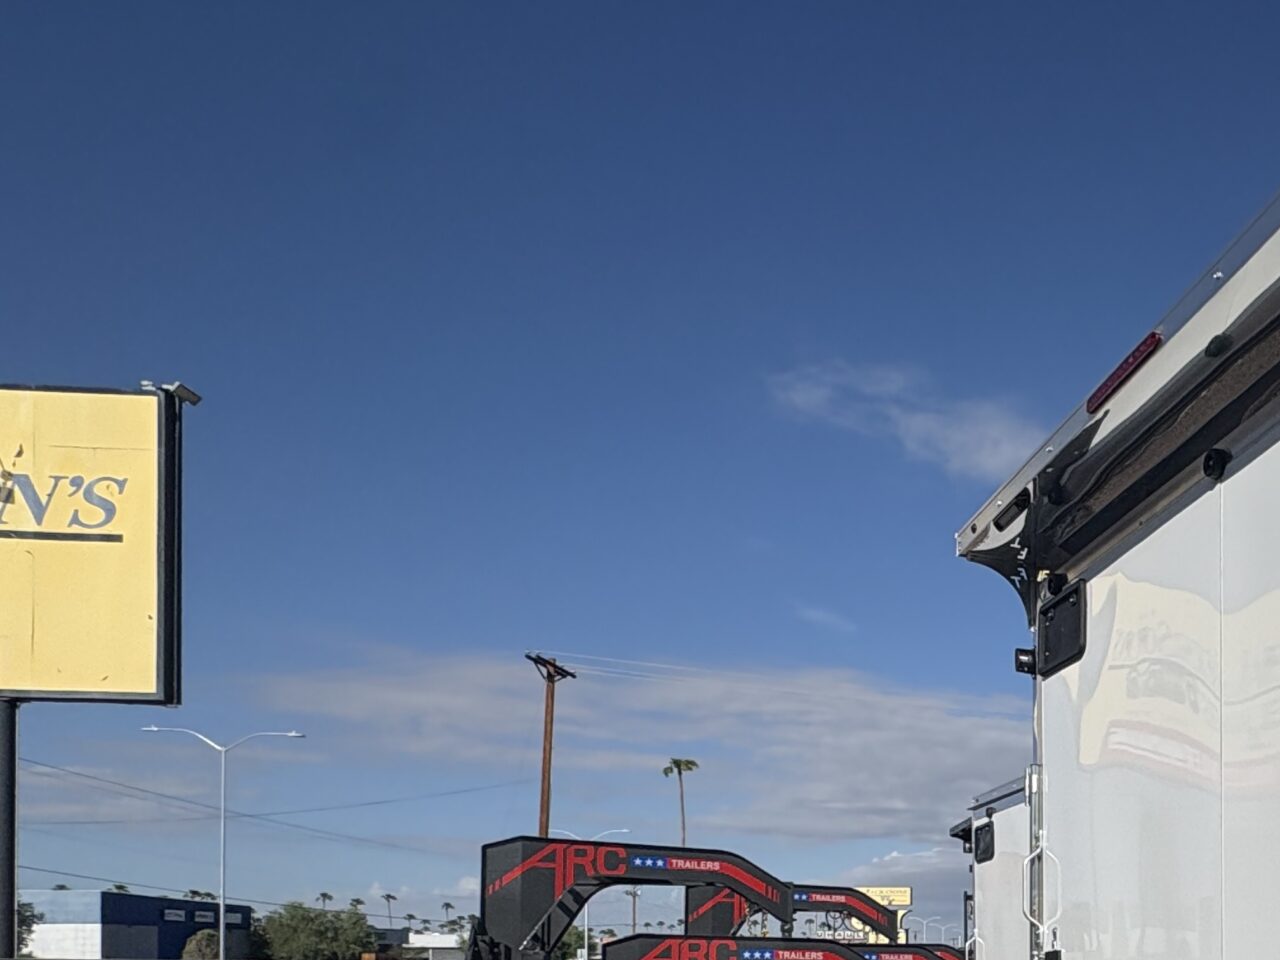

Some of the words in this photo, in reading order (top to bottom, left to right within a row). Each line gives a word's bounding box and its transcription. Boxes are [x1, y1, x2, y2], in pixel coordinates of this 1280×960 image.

[494, 843, 627, 900] ARC
[671, 858, 721, 872] TRAILERS
[812, 894, 846, 903] TRAILERS
[777, 951, 823, 960] TRAILERS
